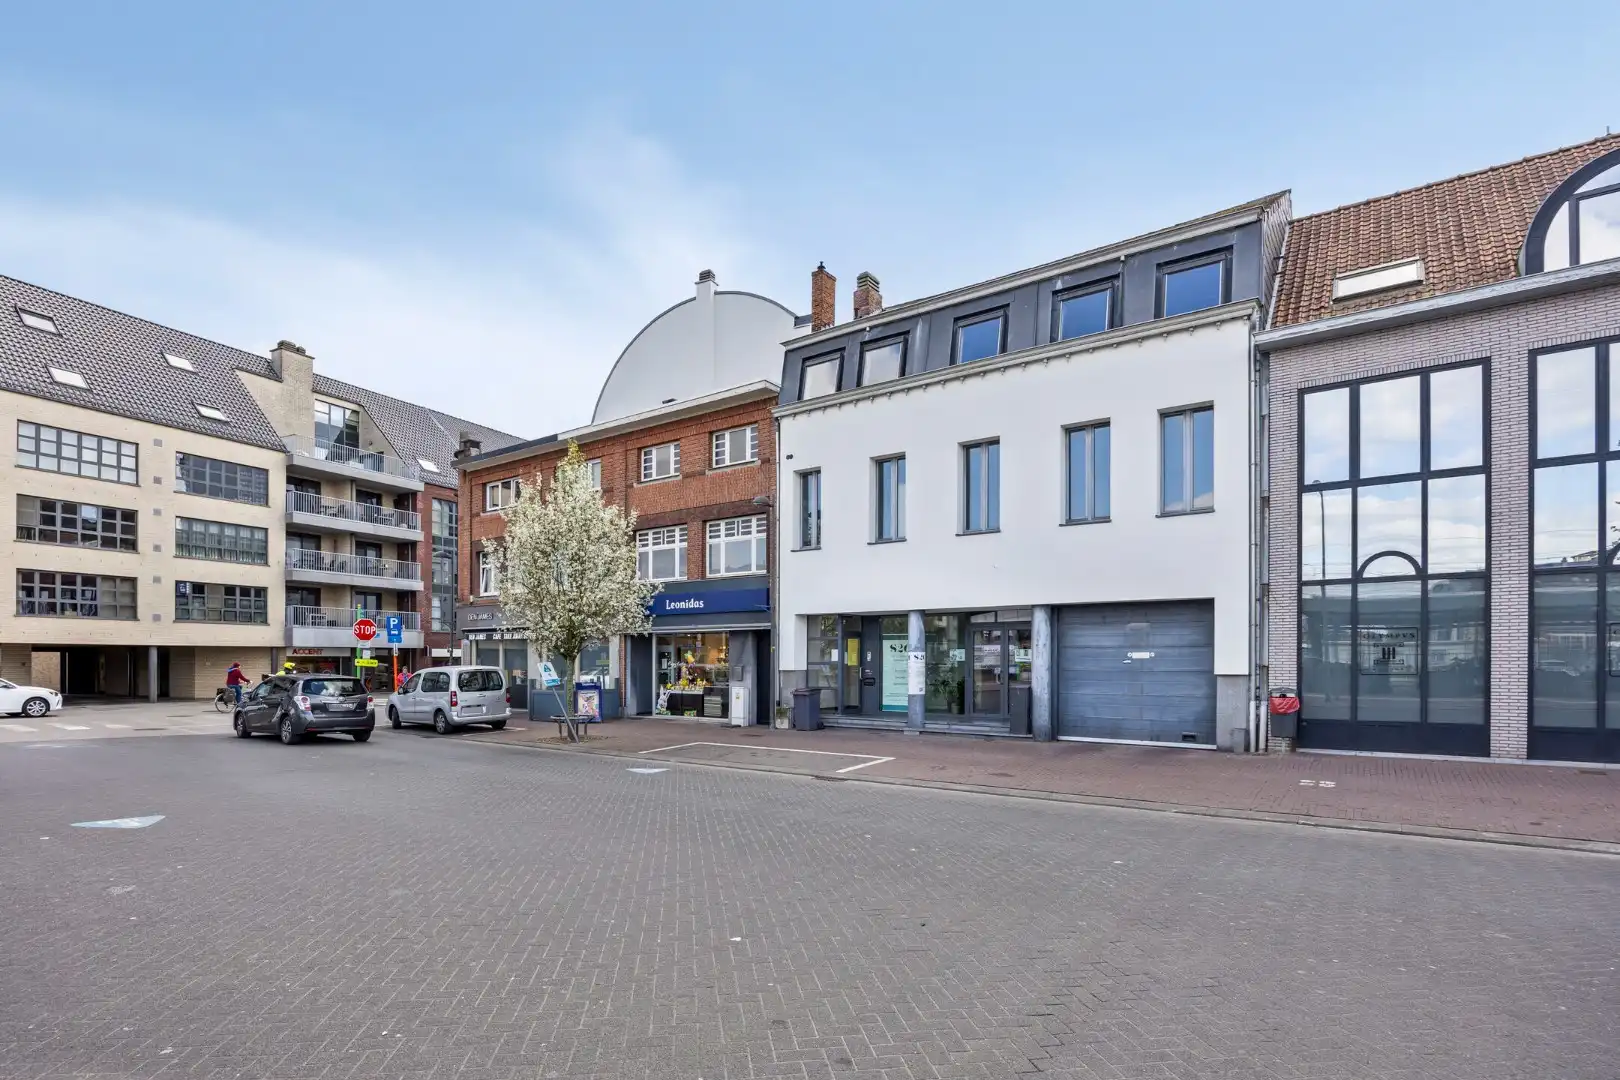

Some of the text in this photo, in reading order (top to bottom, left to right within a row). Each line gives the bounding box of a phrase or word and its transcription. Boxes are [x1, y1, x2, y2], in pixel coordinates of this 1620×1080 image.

[665, 598, 704, 610] Leonidas
[390, 617, 398, 629] P
[354, 625, 376, 635] STOP
